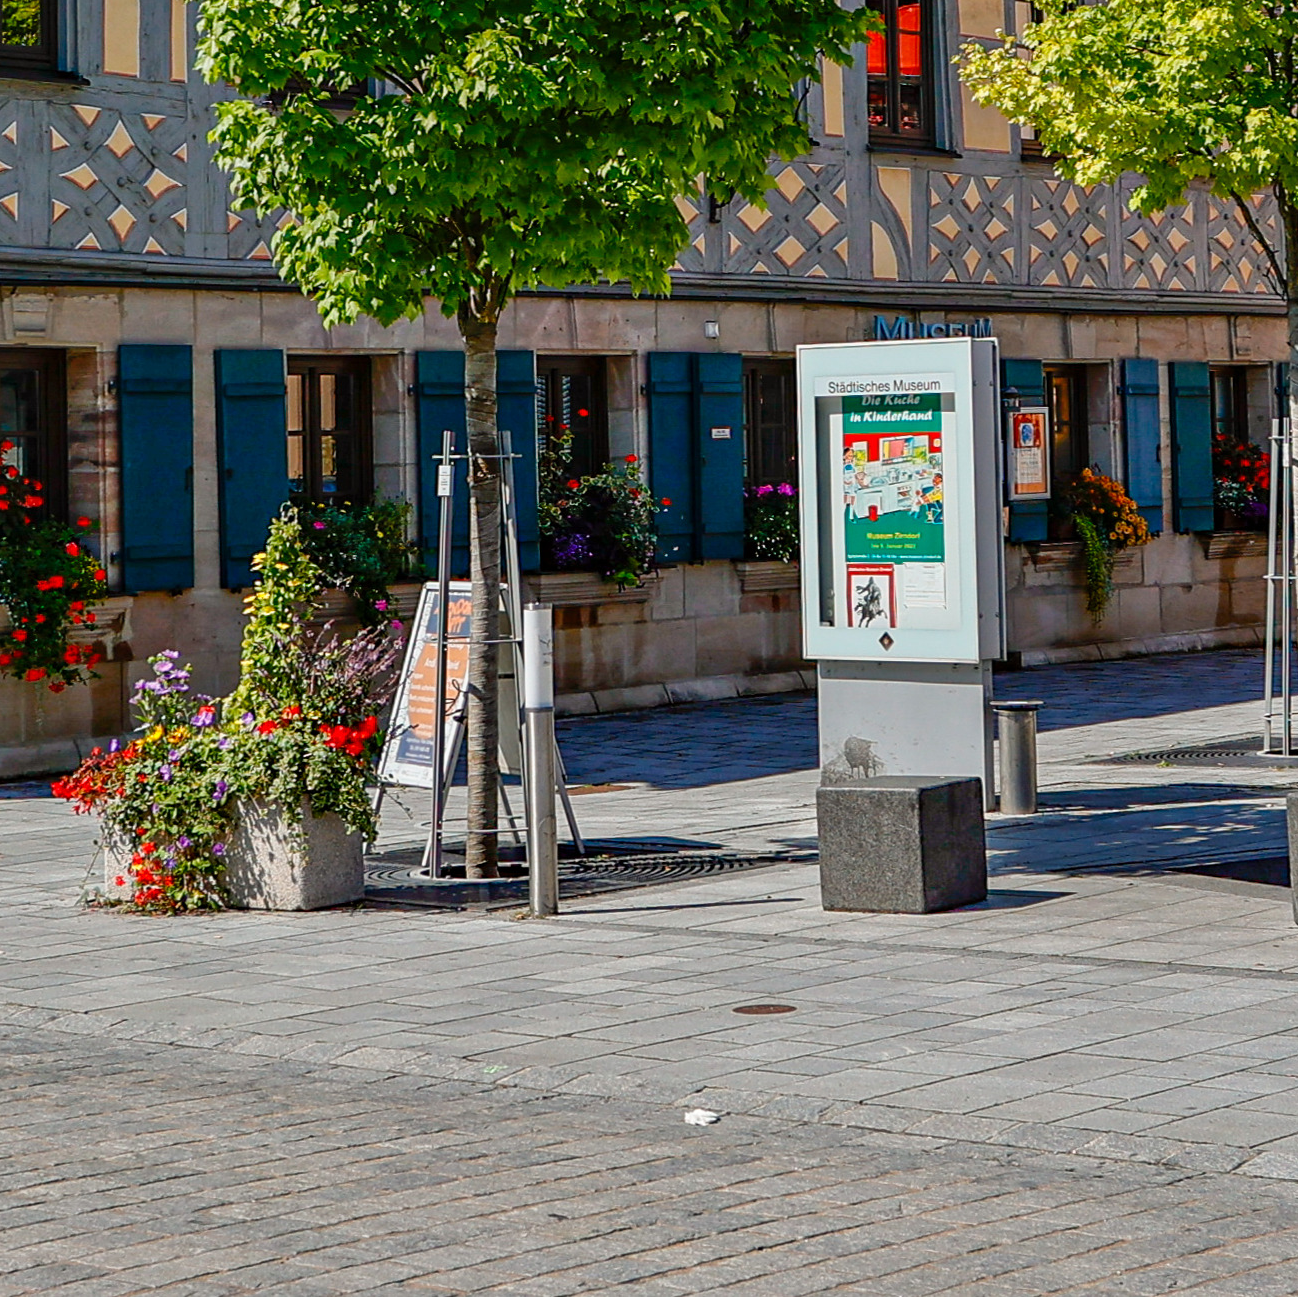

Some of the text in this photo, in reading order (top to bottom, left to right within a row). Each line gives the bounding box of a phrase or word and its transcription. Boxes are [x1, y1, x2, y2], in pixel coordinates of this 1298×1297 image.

[828, 379, 941, 393] Städtisches Museum
[861, 393, 881, 406] Die
[850, 409, 933, 422] in Kinderhand
